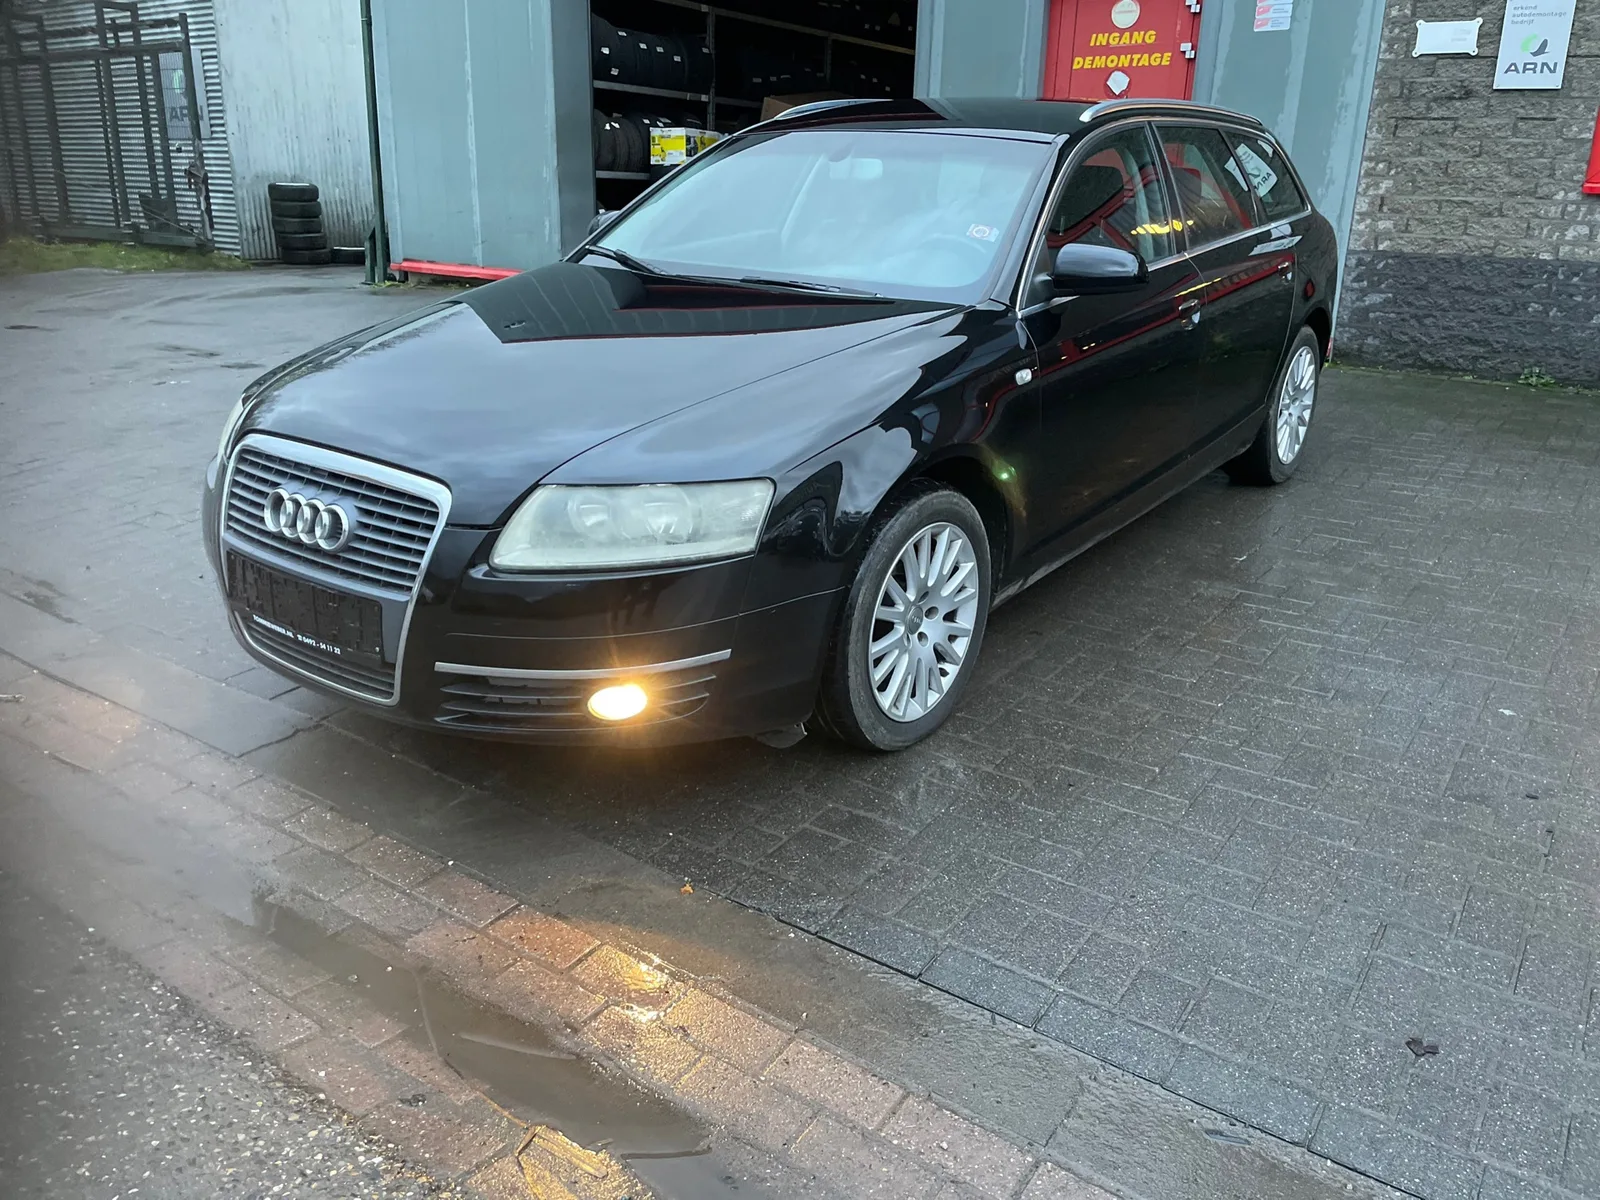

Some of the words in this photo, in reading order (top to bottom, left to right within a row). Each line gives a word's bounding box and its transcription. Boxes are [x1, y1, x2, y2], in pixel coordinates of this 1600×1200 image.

[1089, 30, 1157, 47] INGANG
[1072, 52, 1172, 70] DEMONTAGE
[1503, 62, 1558, 75] ARN
